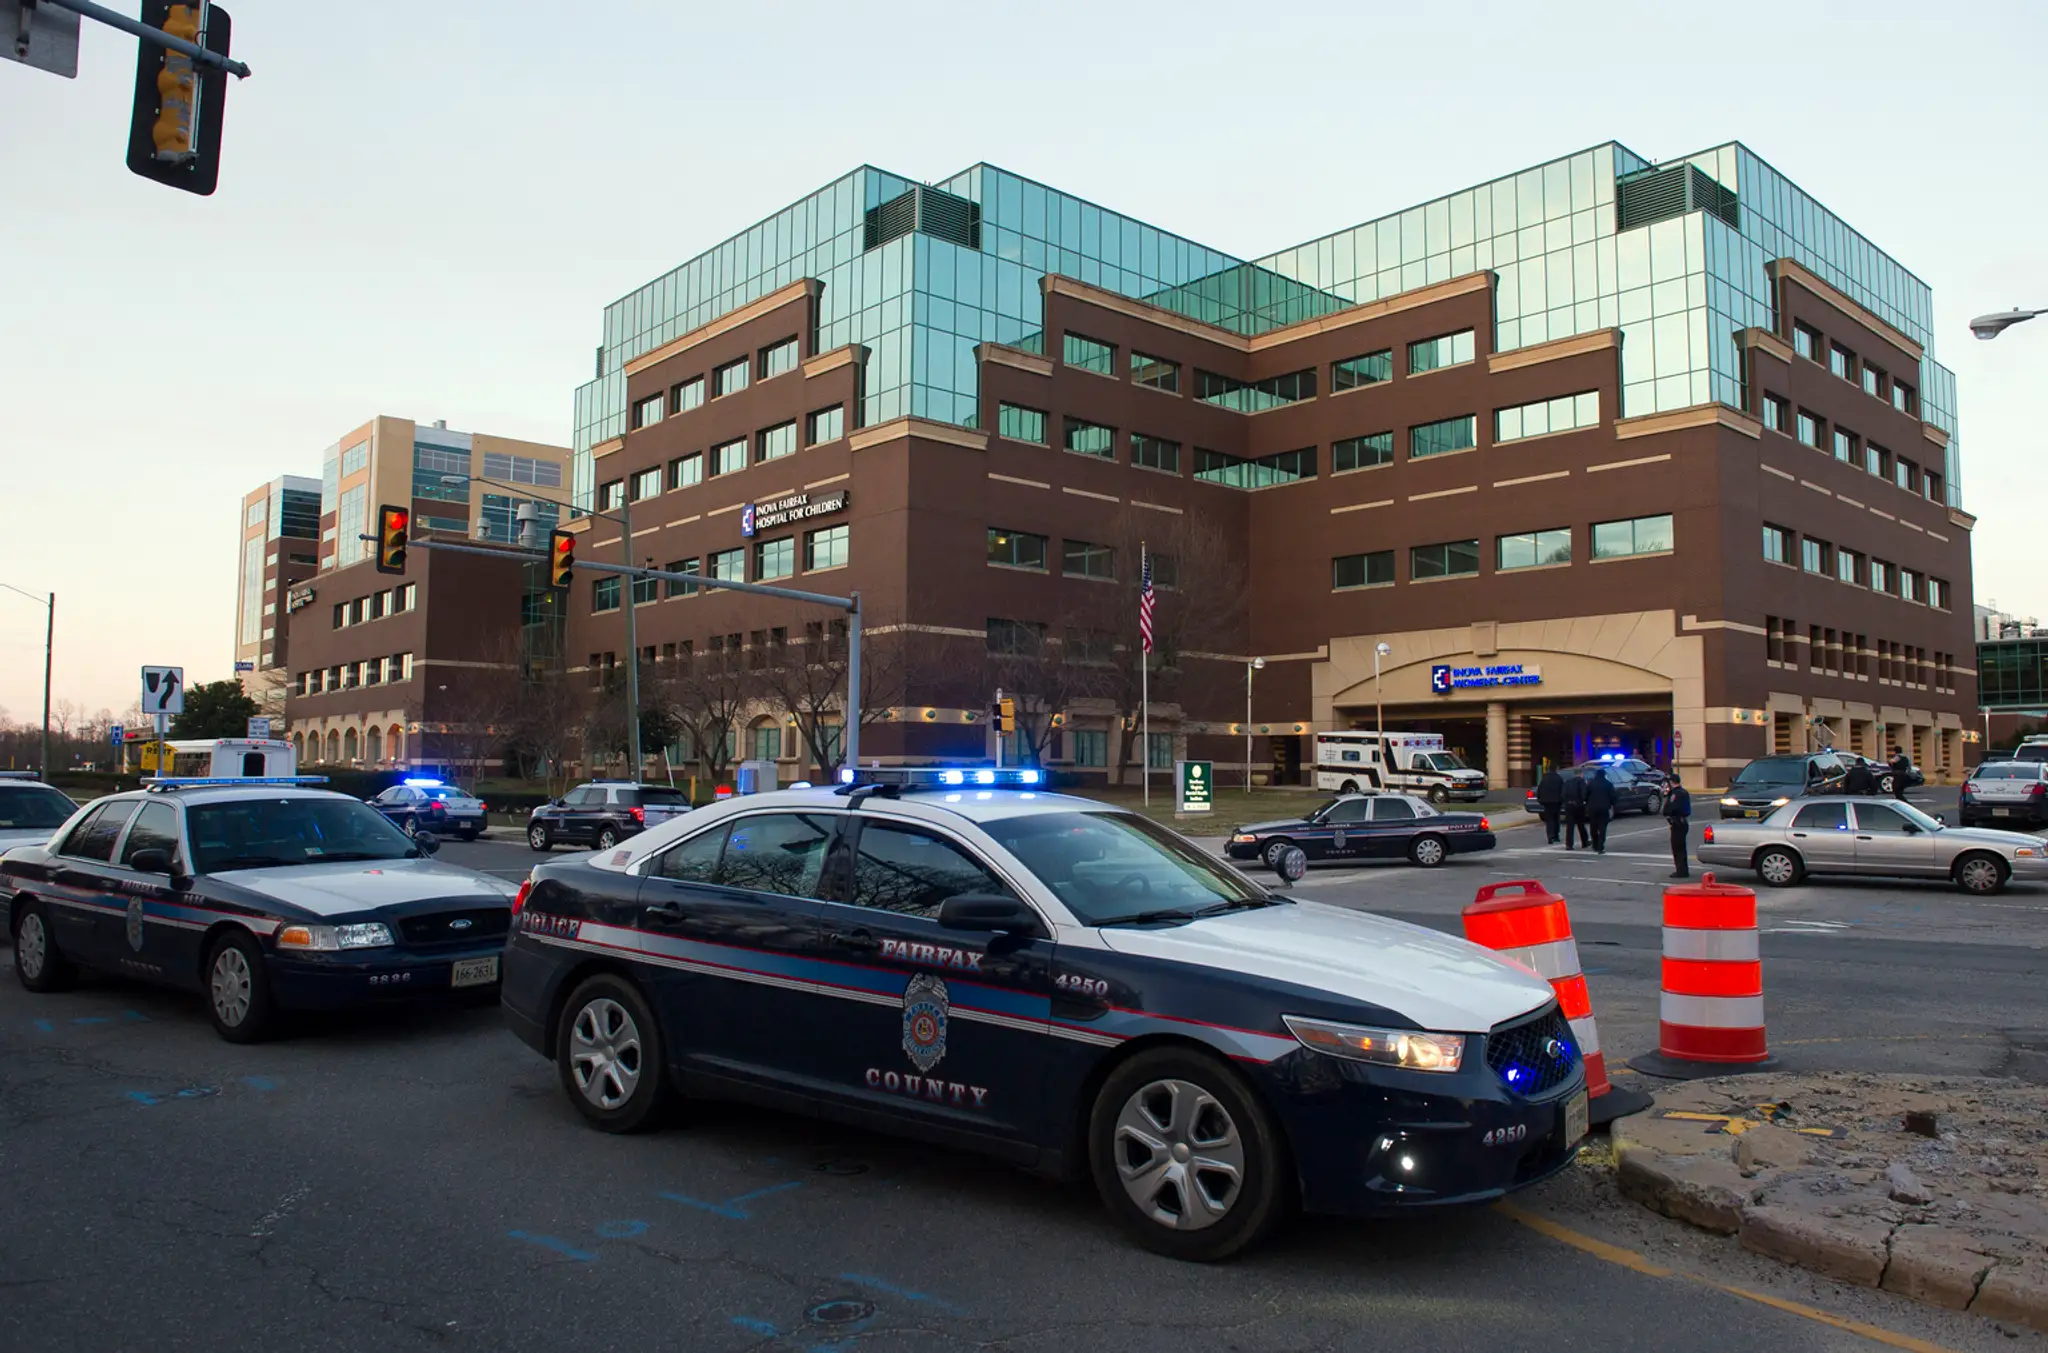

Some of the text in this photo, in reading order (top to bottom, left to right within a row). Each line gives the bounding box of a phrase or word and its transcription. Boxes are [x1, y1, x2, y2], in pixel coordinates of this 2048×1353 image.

[756, 494, 808, 516] INOVA FAIRFAX
[756, 498, 843, 529] HOSPITAL FOR CHILDREN
[522, 911, 580, 939] POLICE
[879, 938, 984, 973] FAIRFAX
[1055, 973, 1109, 996] 4250
[865, 1067, 988, 1108] COUNTY
[1482, 1123, 1527, 1147] 4250
